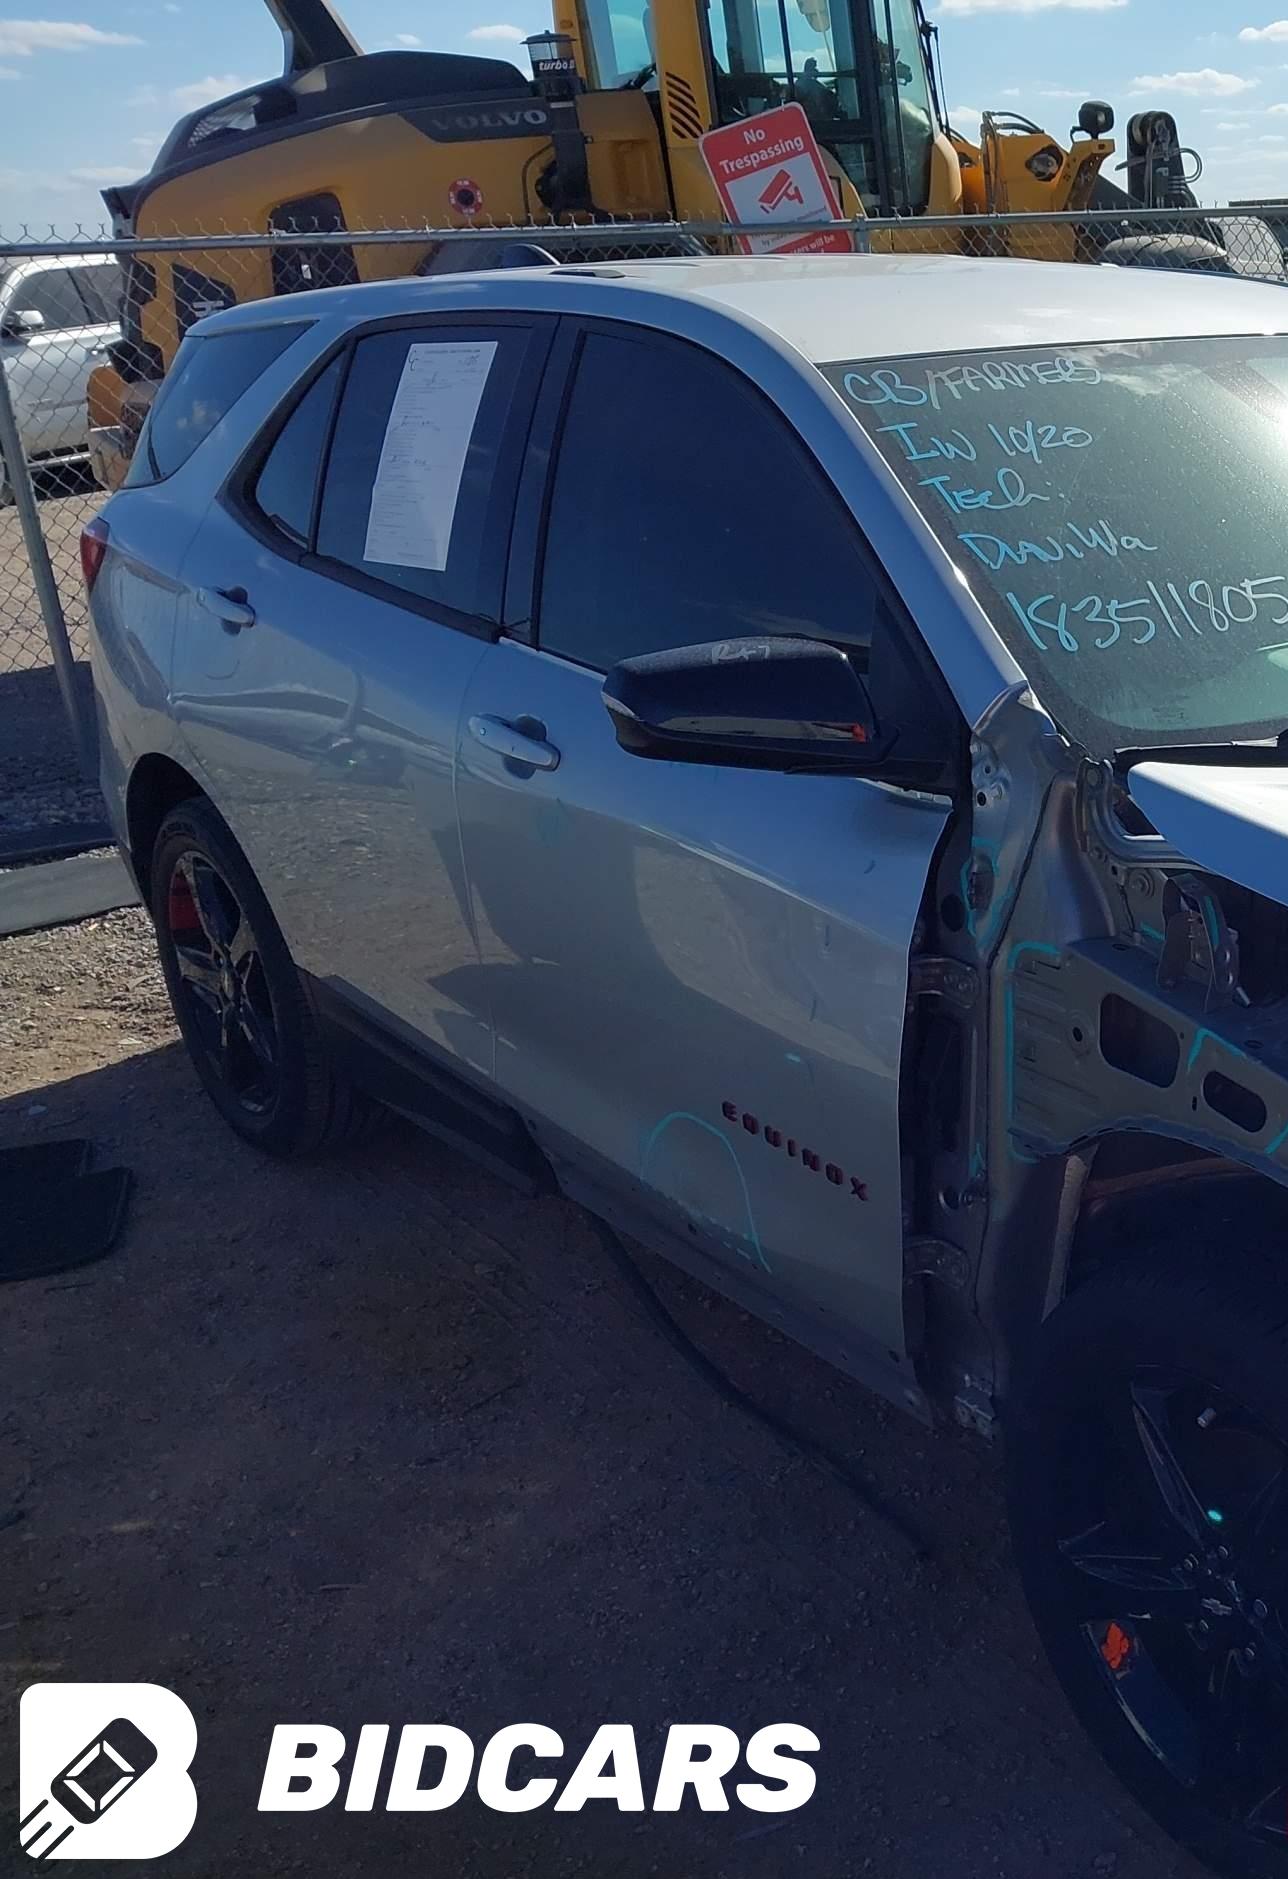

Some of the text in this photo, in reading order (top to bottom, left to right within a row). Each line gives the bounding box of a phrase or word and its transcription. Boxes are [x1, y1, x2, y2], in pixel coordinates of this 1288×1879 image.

[539, 60, 568, 71] turbo
[432, 109, 547, 131] VOLVO
[743, 128, 766, 145] No
[719, 135, 805, 175] Trespassing
[987, 420, 1092, 465] 10/20
[722, 1100, 868, 1202] EQUINOX
